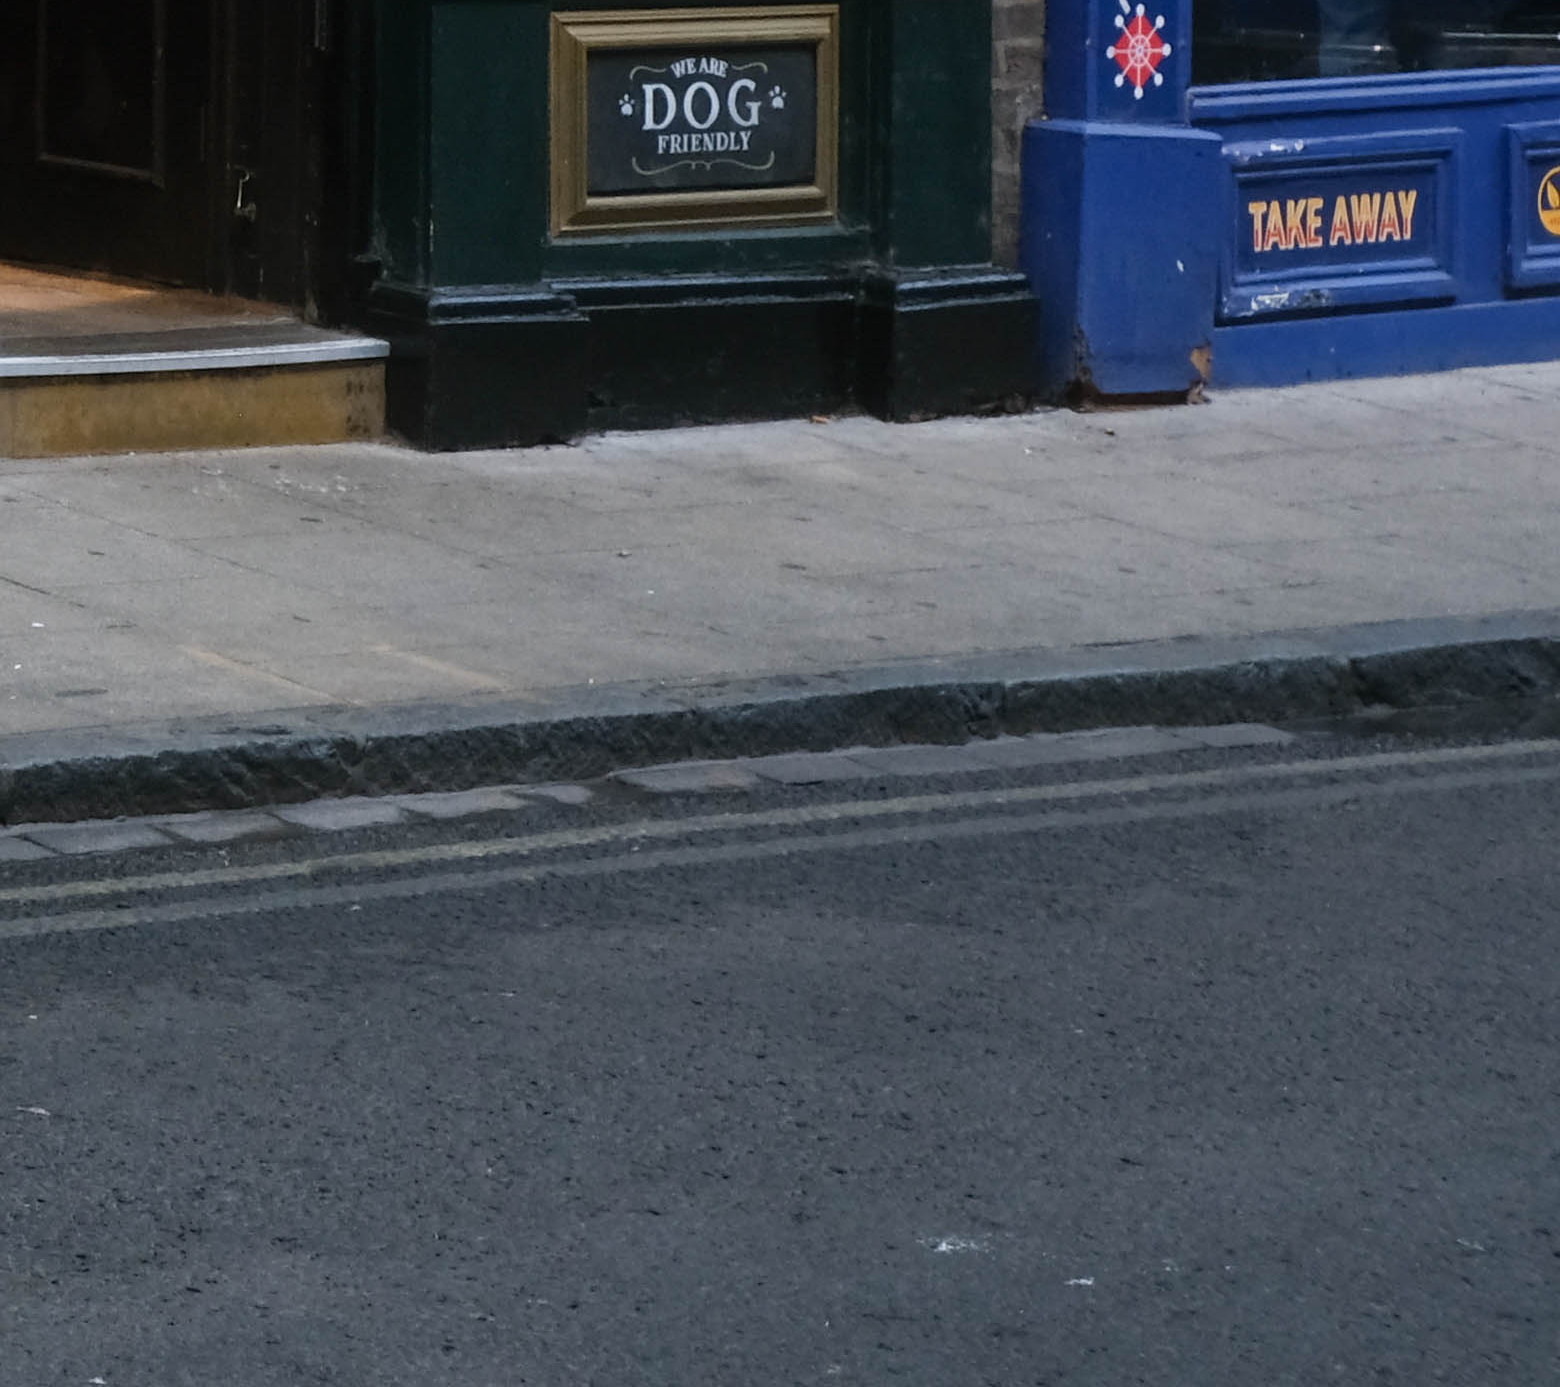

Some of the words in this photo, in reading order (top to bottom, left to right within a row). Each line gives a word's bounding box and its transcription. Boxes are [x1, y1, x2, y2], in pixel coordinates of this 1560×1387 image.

[670, 57, 698, 78] WE
[698, 57, 730, 78] ARE
[641, 78, 763, 131] DOG
[657, 129, 753, 155] FRIENDLY
[1247, 196, 1323, 255] TAKE
[1328, 188, 1419, 249] AWAY
